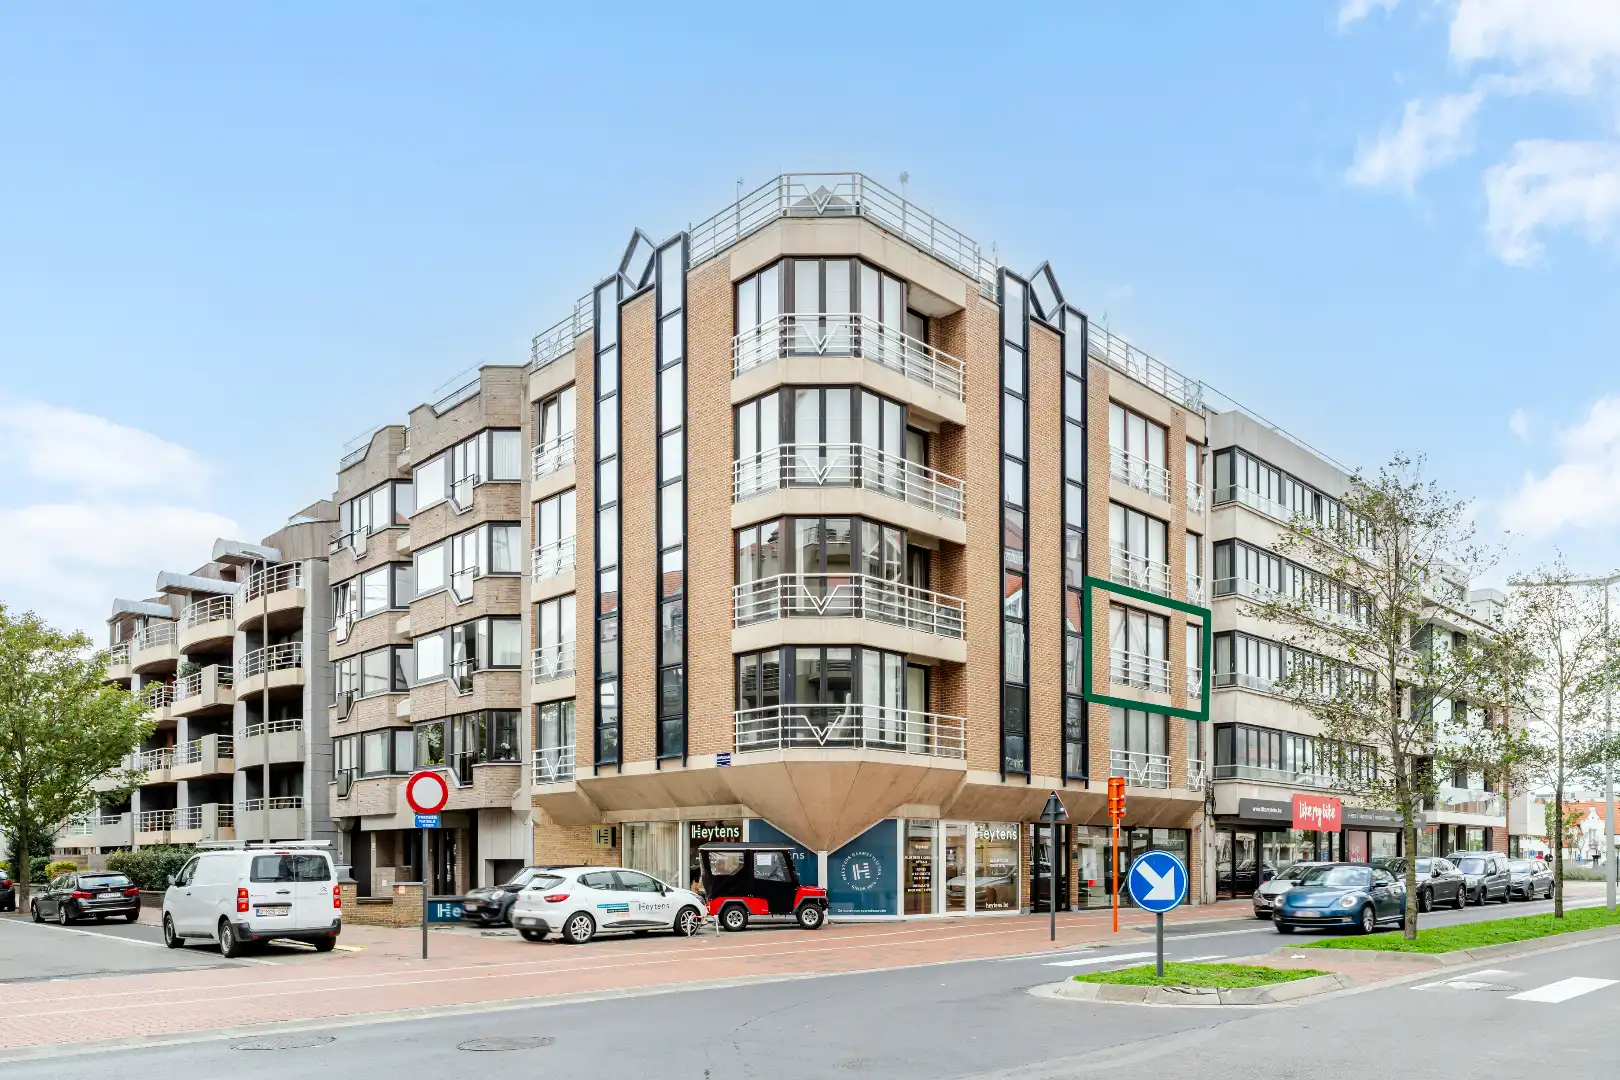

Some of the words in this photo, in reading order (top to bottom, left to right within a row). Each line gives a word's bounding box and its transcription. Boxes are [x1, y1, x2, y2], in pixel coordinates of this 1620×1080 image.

[691, 824, 740, 842] Heytens
[975, 824, 1018, 843] Heytens
[638, 902, 670, 912] Heytens
